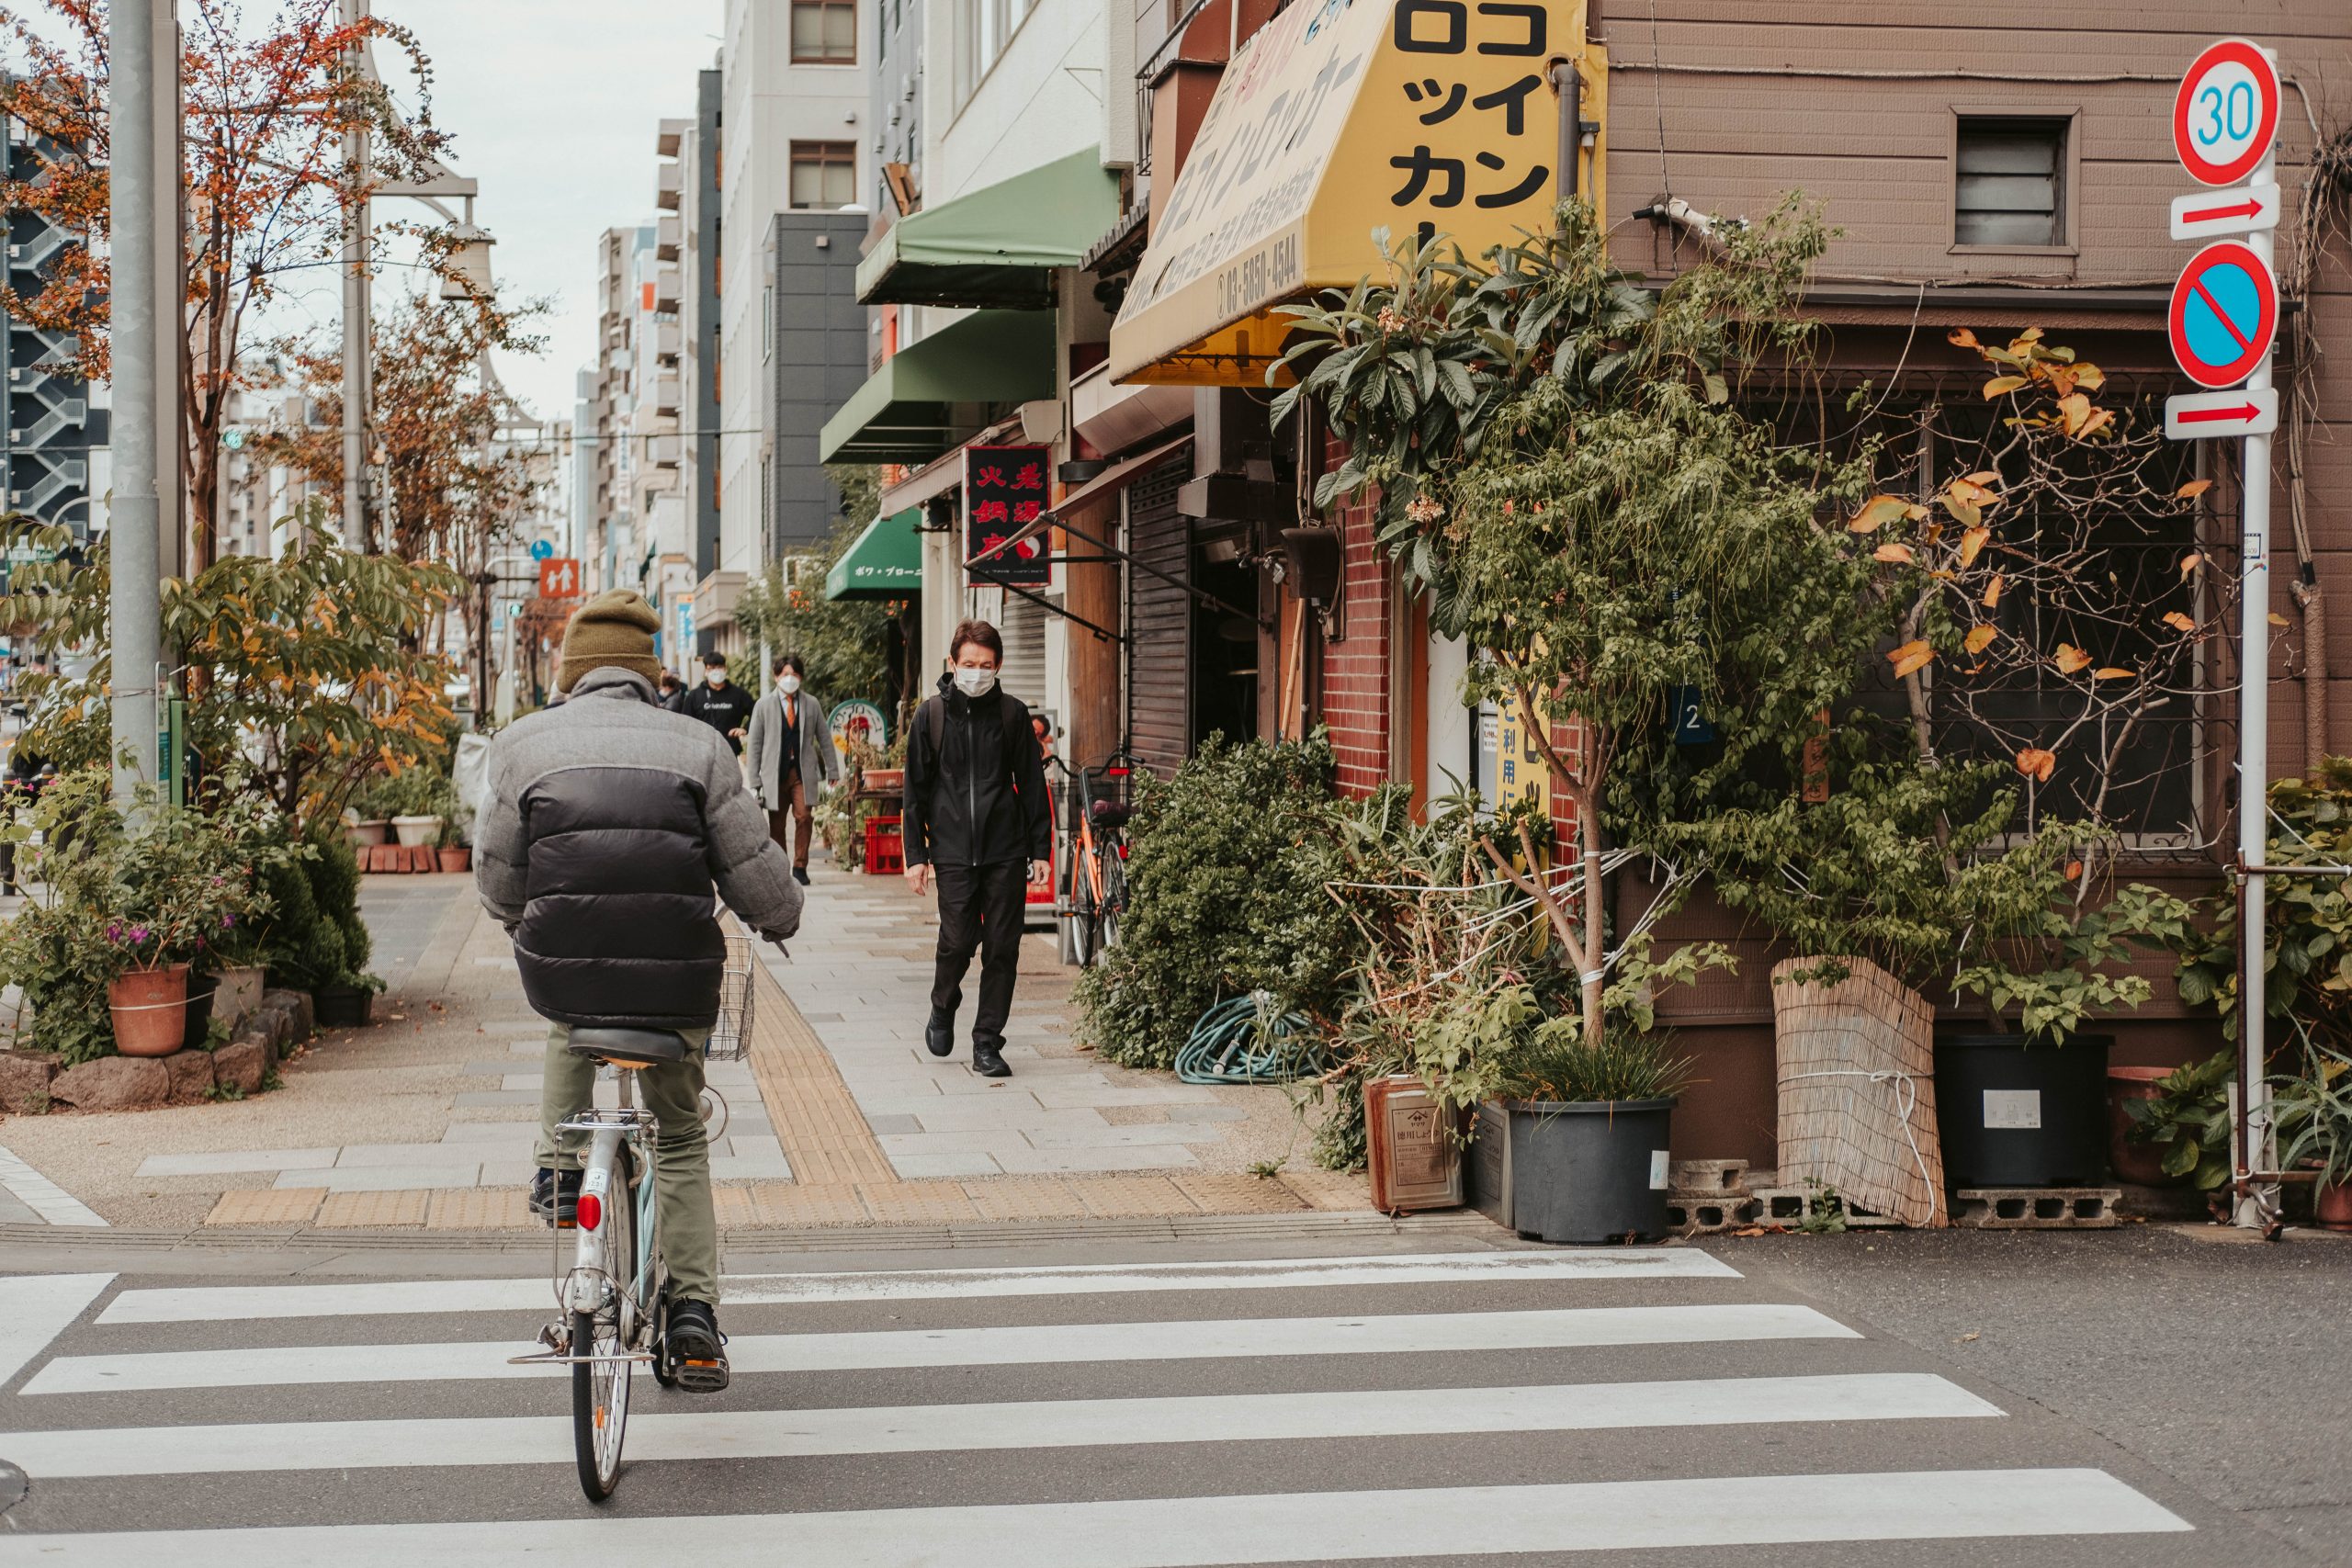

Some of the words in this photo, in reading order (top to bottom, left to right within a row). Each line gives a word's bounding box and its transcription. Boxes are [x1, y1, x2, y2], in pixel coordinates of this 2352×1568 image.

[1172, 44, 1362, 232] コインロッカー
[1472, 3, 1549, 209] コイン
[2198, 81, 2254, 146] 30
[1227, 233, 1296, 315] 03-5850-4544
[1686, 705, 1701, 728] 2
